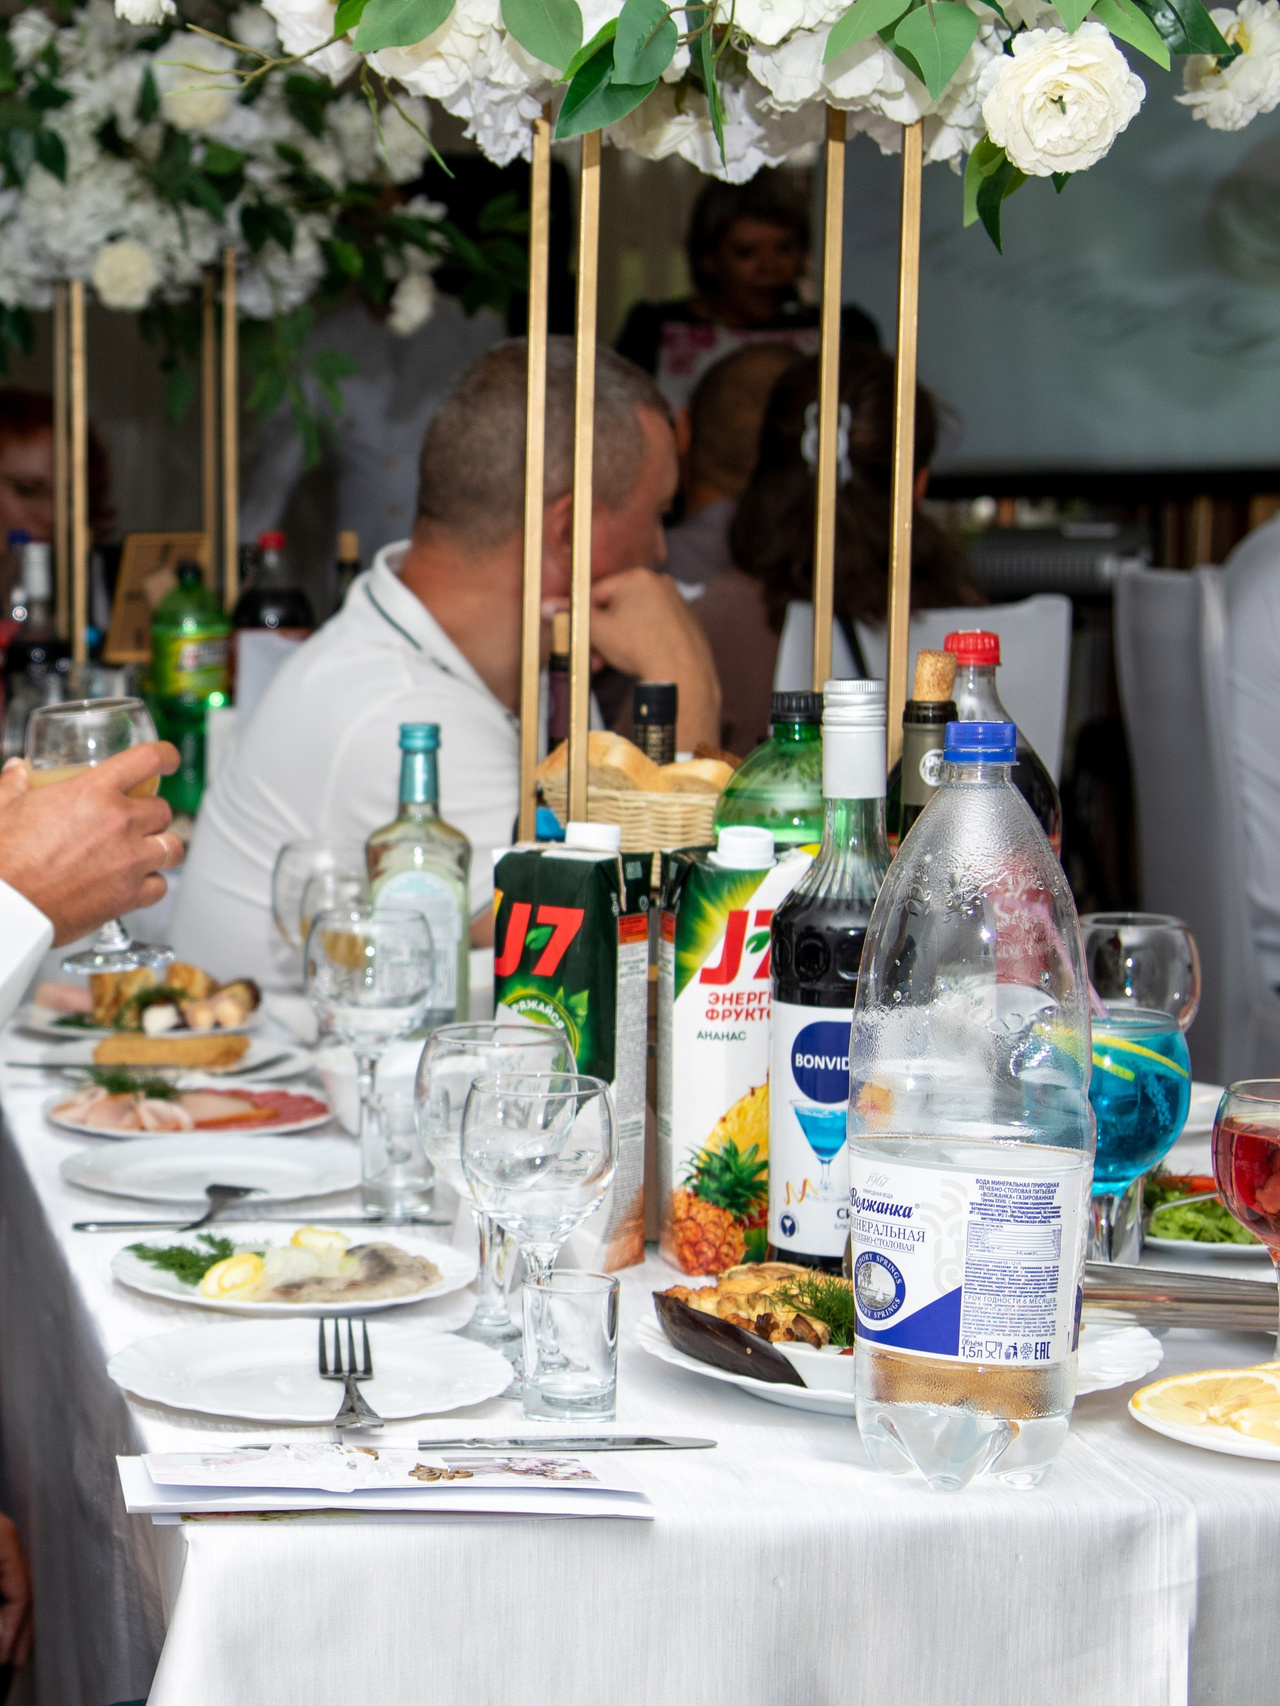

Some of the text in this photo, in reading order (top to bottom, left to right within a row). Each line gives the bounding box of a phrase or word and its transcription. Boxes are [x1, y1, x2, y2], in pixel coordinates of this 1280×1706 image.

[495, 902, 585, 978] J7
[512, 999, 565, 1029] РЯЖАЙСЯ
[697, 1030, 747, 1041] АНАНАС
[795, 1052, 849, 1071] BONVID
[991, 1180, 1030, 1188] МИНЕРАЛЬНАЯ
[876, 1254, 902, 1284] SPRINGS
[874, 1298, 901, 1319] SPRINGS
[964, 1295, 981, 1303] СРОК
